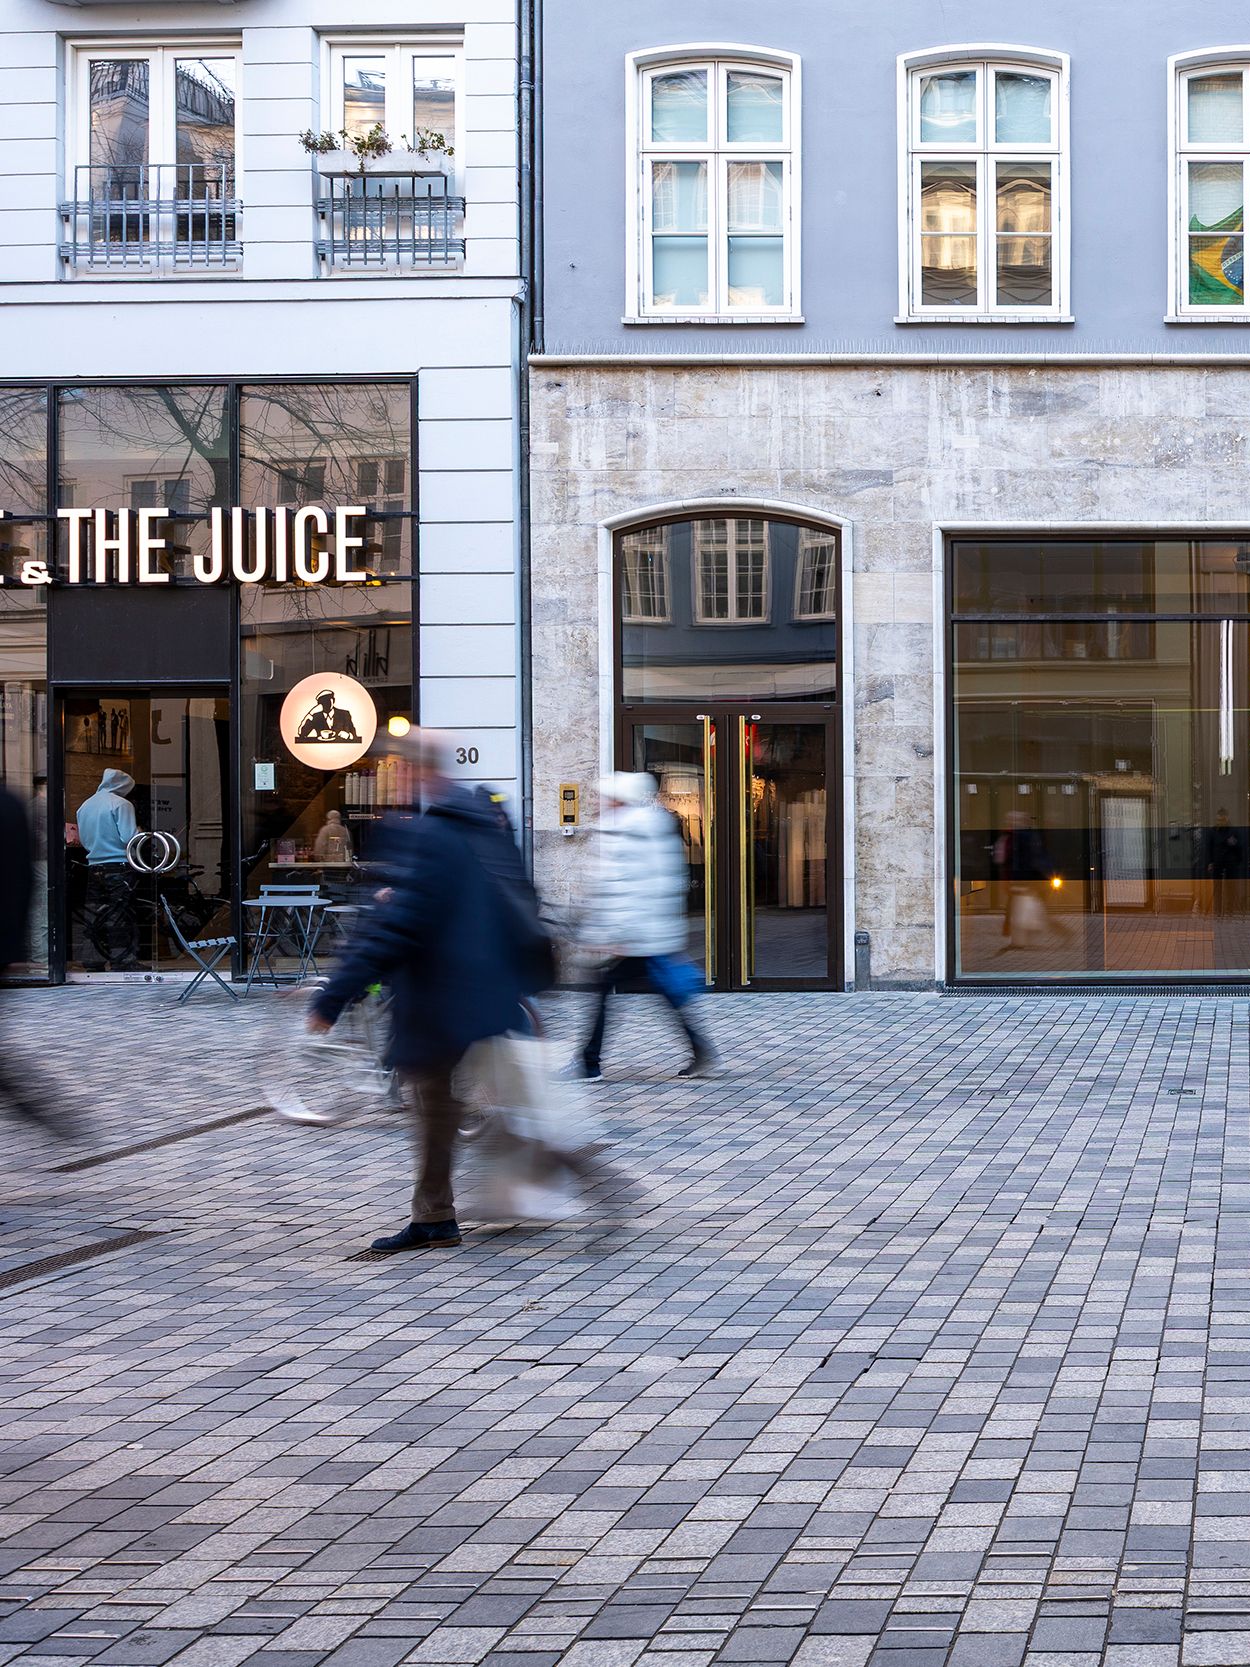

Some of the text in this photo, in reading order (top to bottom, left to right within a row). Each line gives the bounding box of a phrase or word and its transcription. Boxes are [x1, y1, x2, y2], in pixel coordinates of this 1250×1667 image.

[21, 561, 53, 584] &
[57, 508, 170, 583] THE
[193, 506, 367, 584] JUICE
[455, 747, 479, 765] 30
